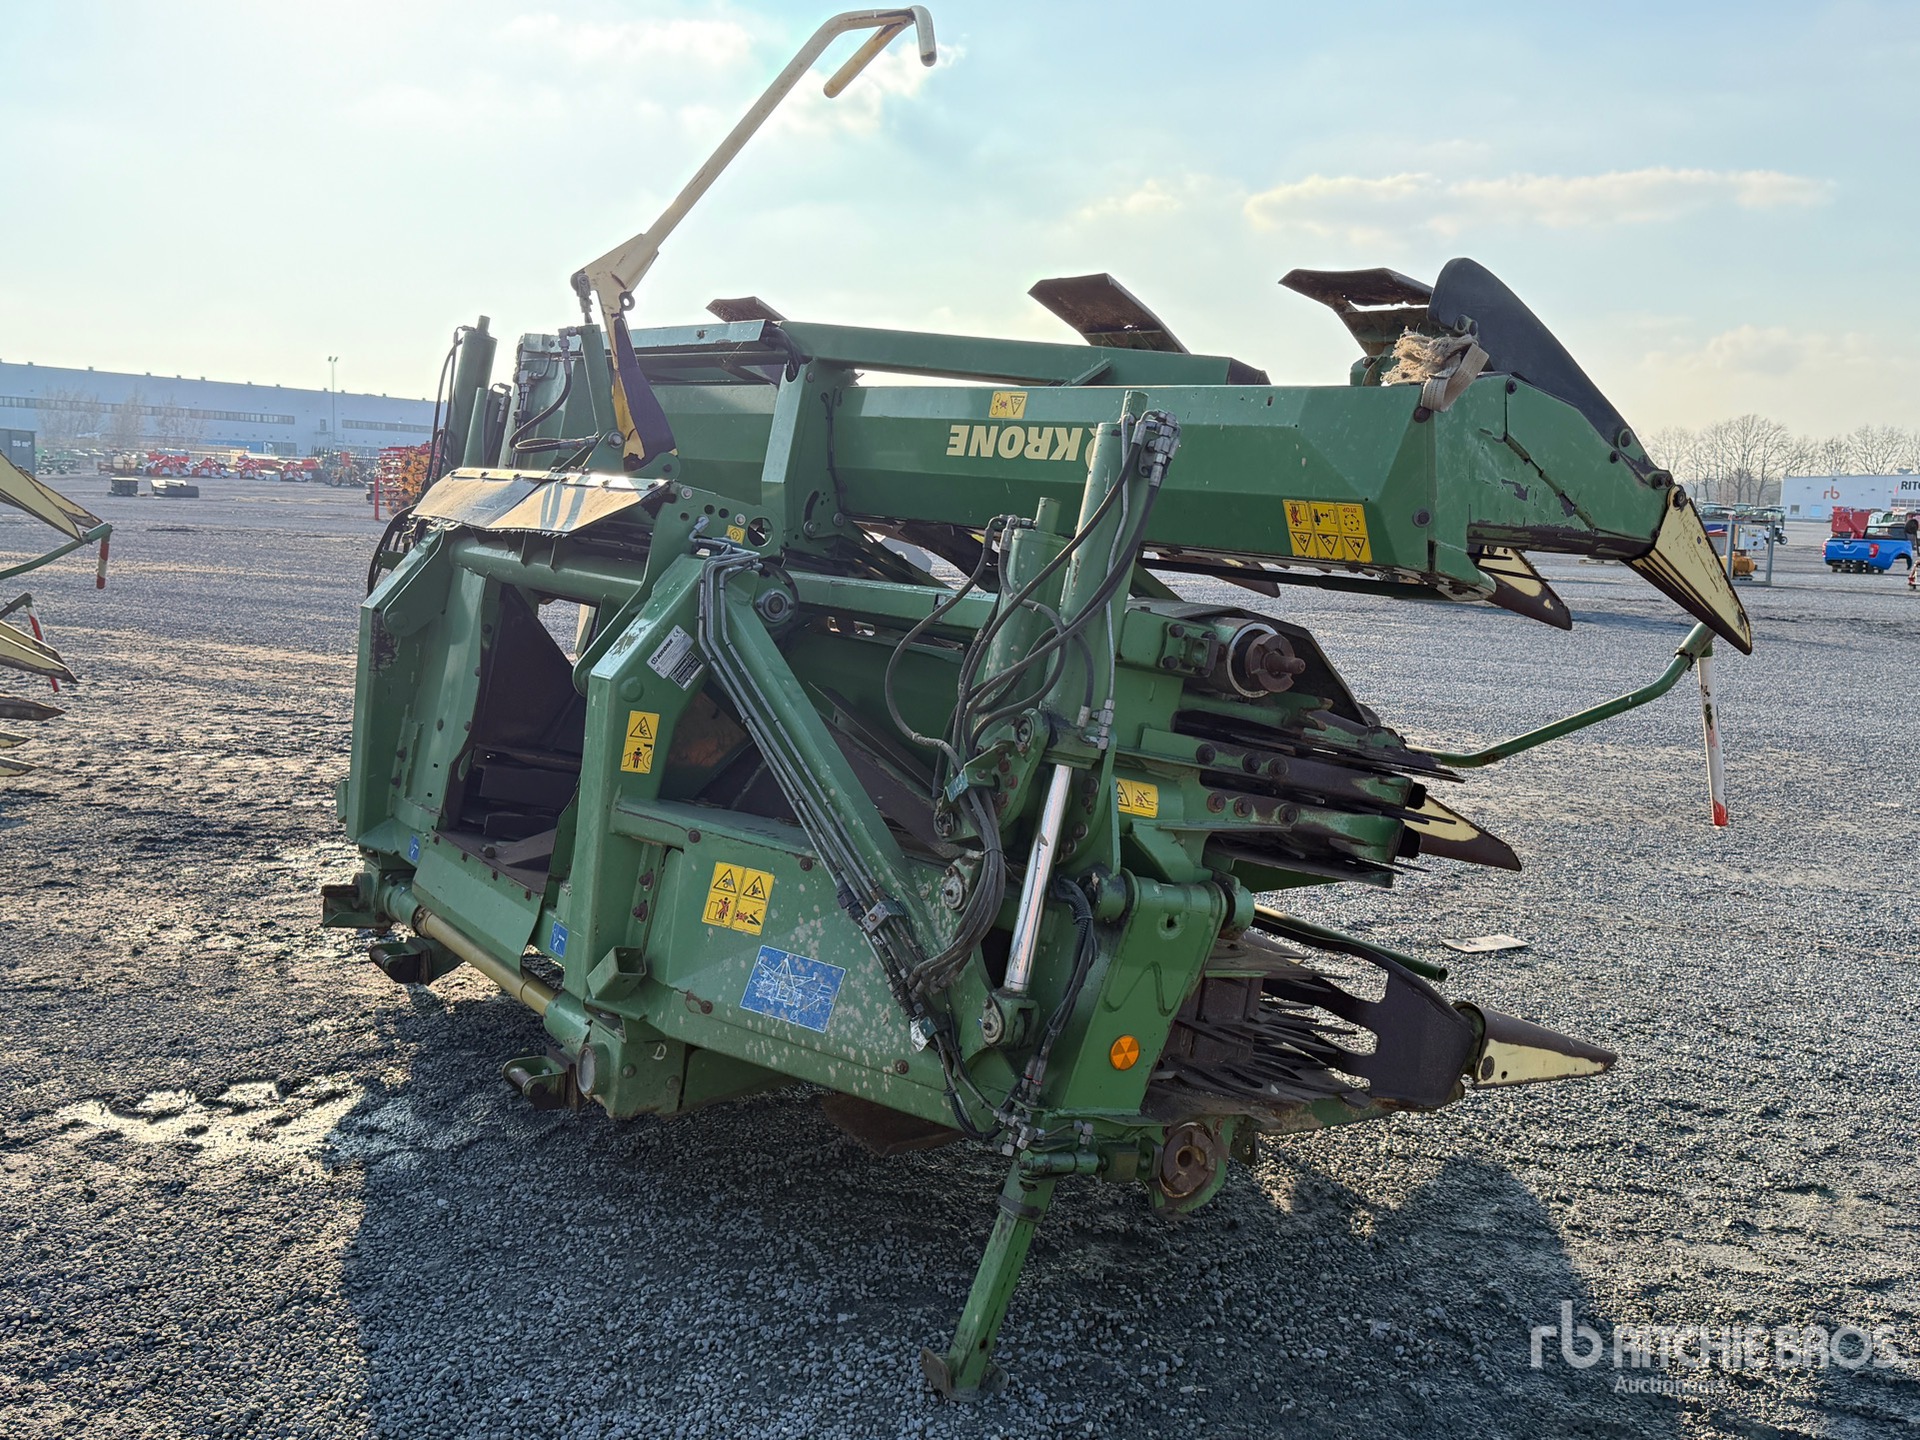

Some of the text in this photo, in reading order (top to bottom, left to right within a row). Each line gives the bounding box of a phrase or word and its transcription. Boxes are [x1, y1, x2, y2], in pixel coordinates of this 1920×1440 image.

[946, 424, 1083, 461] KRONE
[1823, 485, 1840, 500] rb
[1901, 480, 1920, 490] RIT
